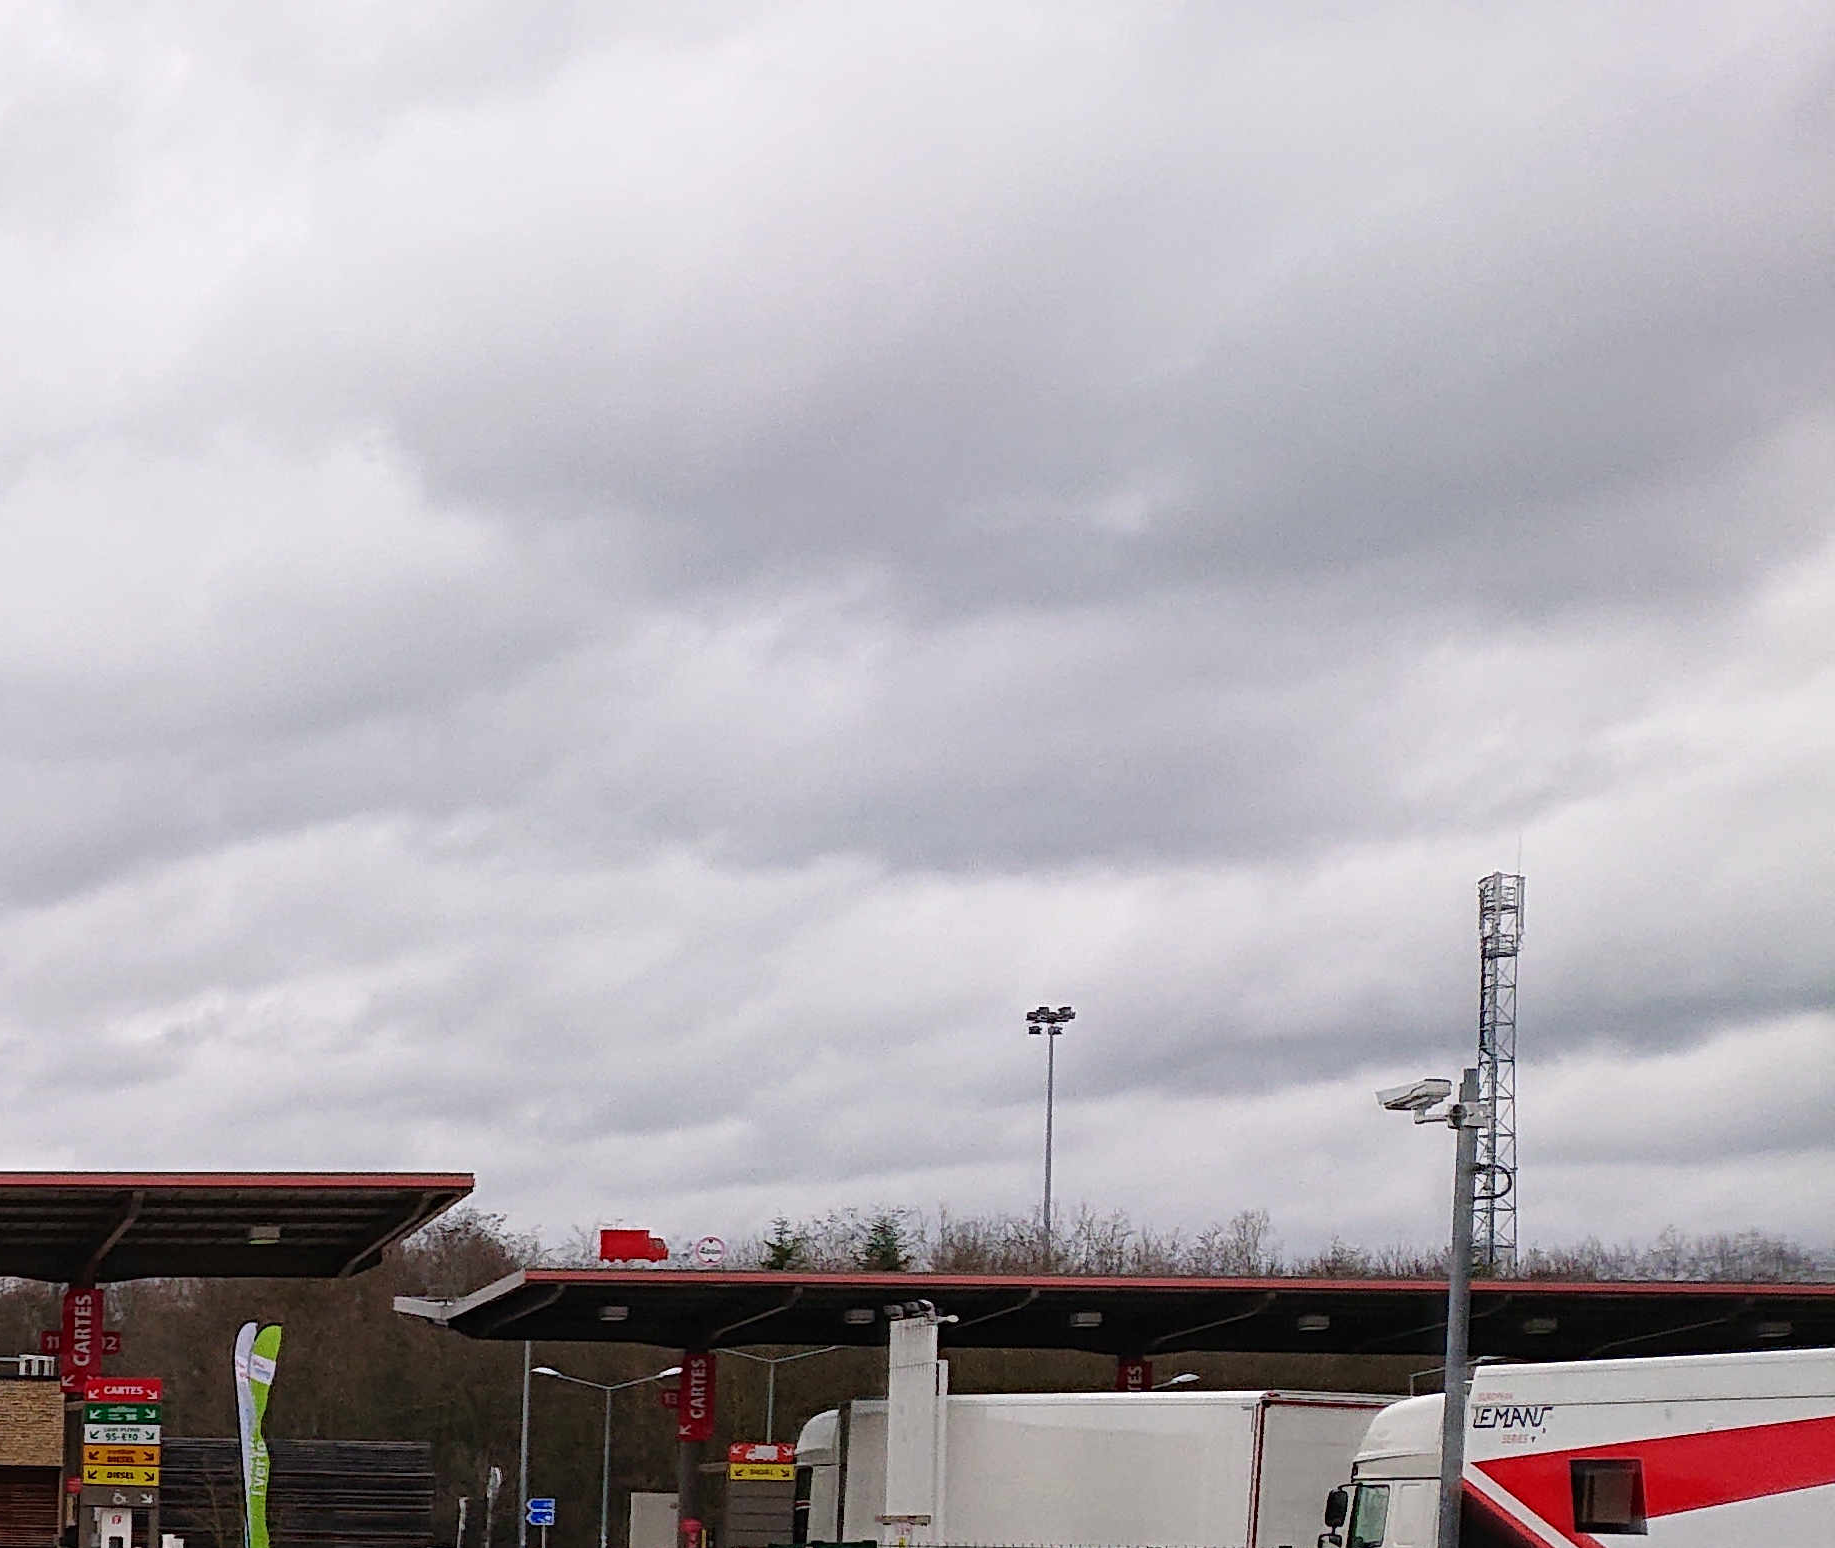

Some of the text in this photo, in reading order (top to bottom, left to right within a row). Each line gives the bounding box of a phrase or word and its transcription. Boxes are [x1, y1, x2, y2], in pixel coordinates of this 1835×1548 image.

[46, 1336, 60, 1349] 11
[72, 1294, 92, 1367] CARTES
[103, 1386, 144, 1395] CARTES
[690, 1360, 706, 1419] CARTES
